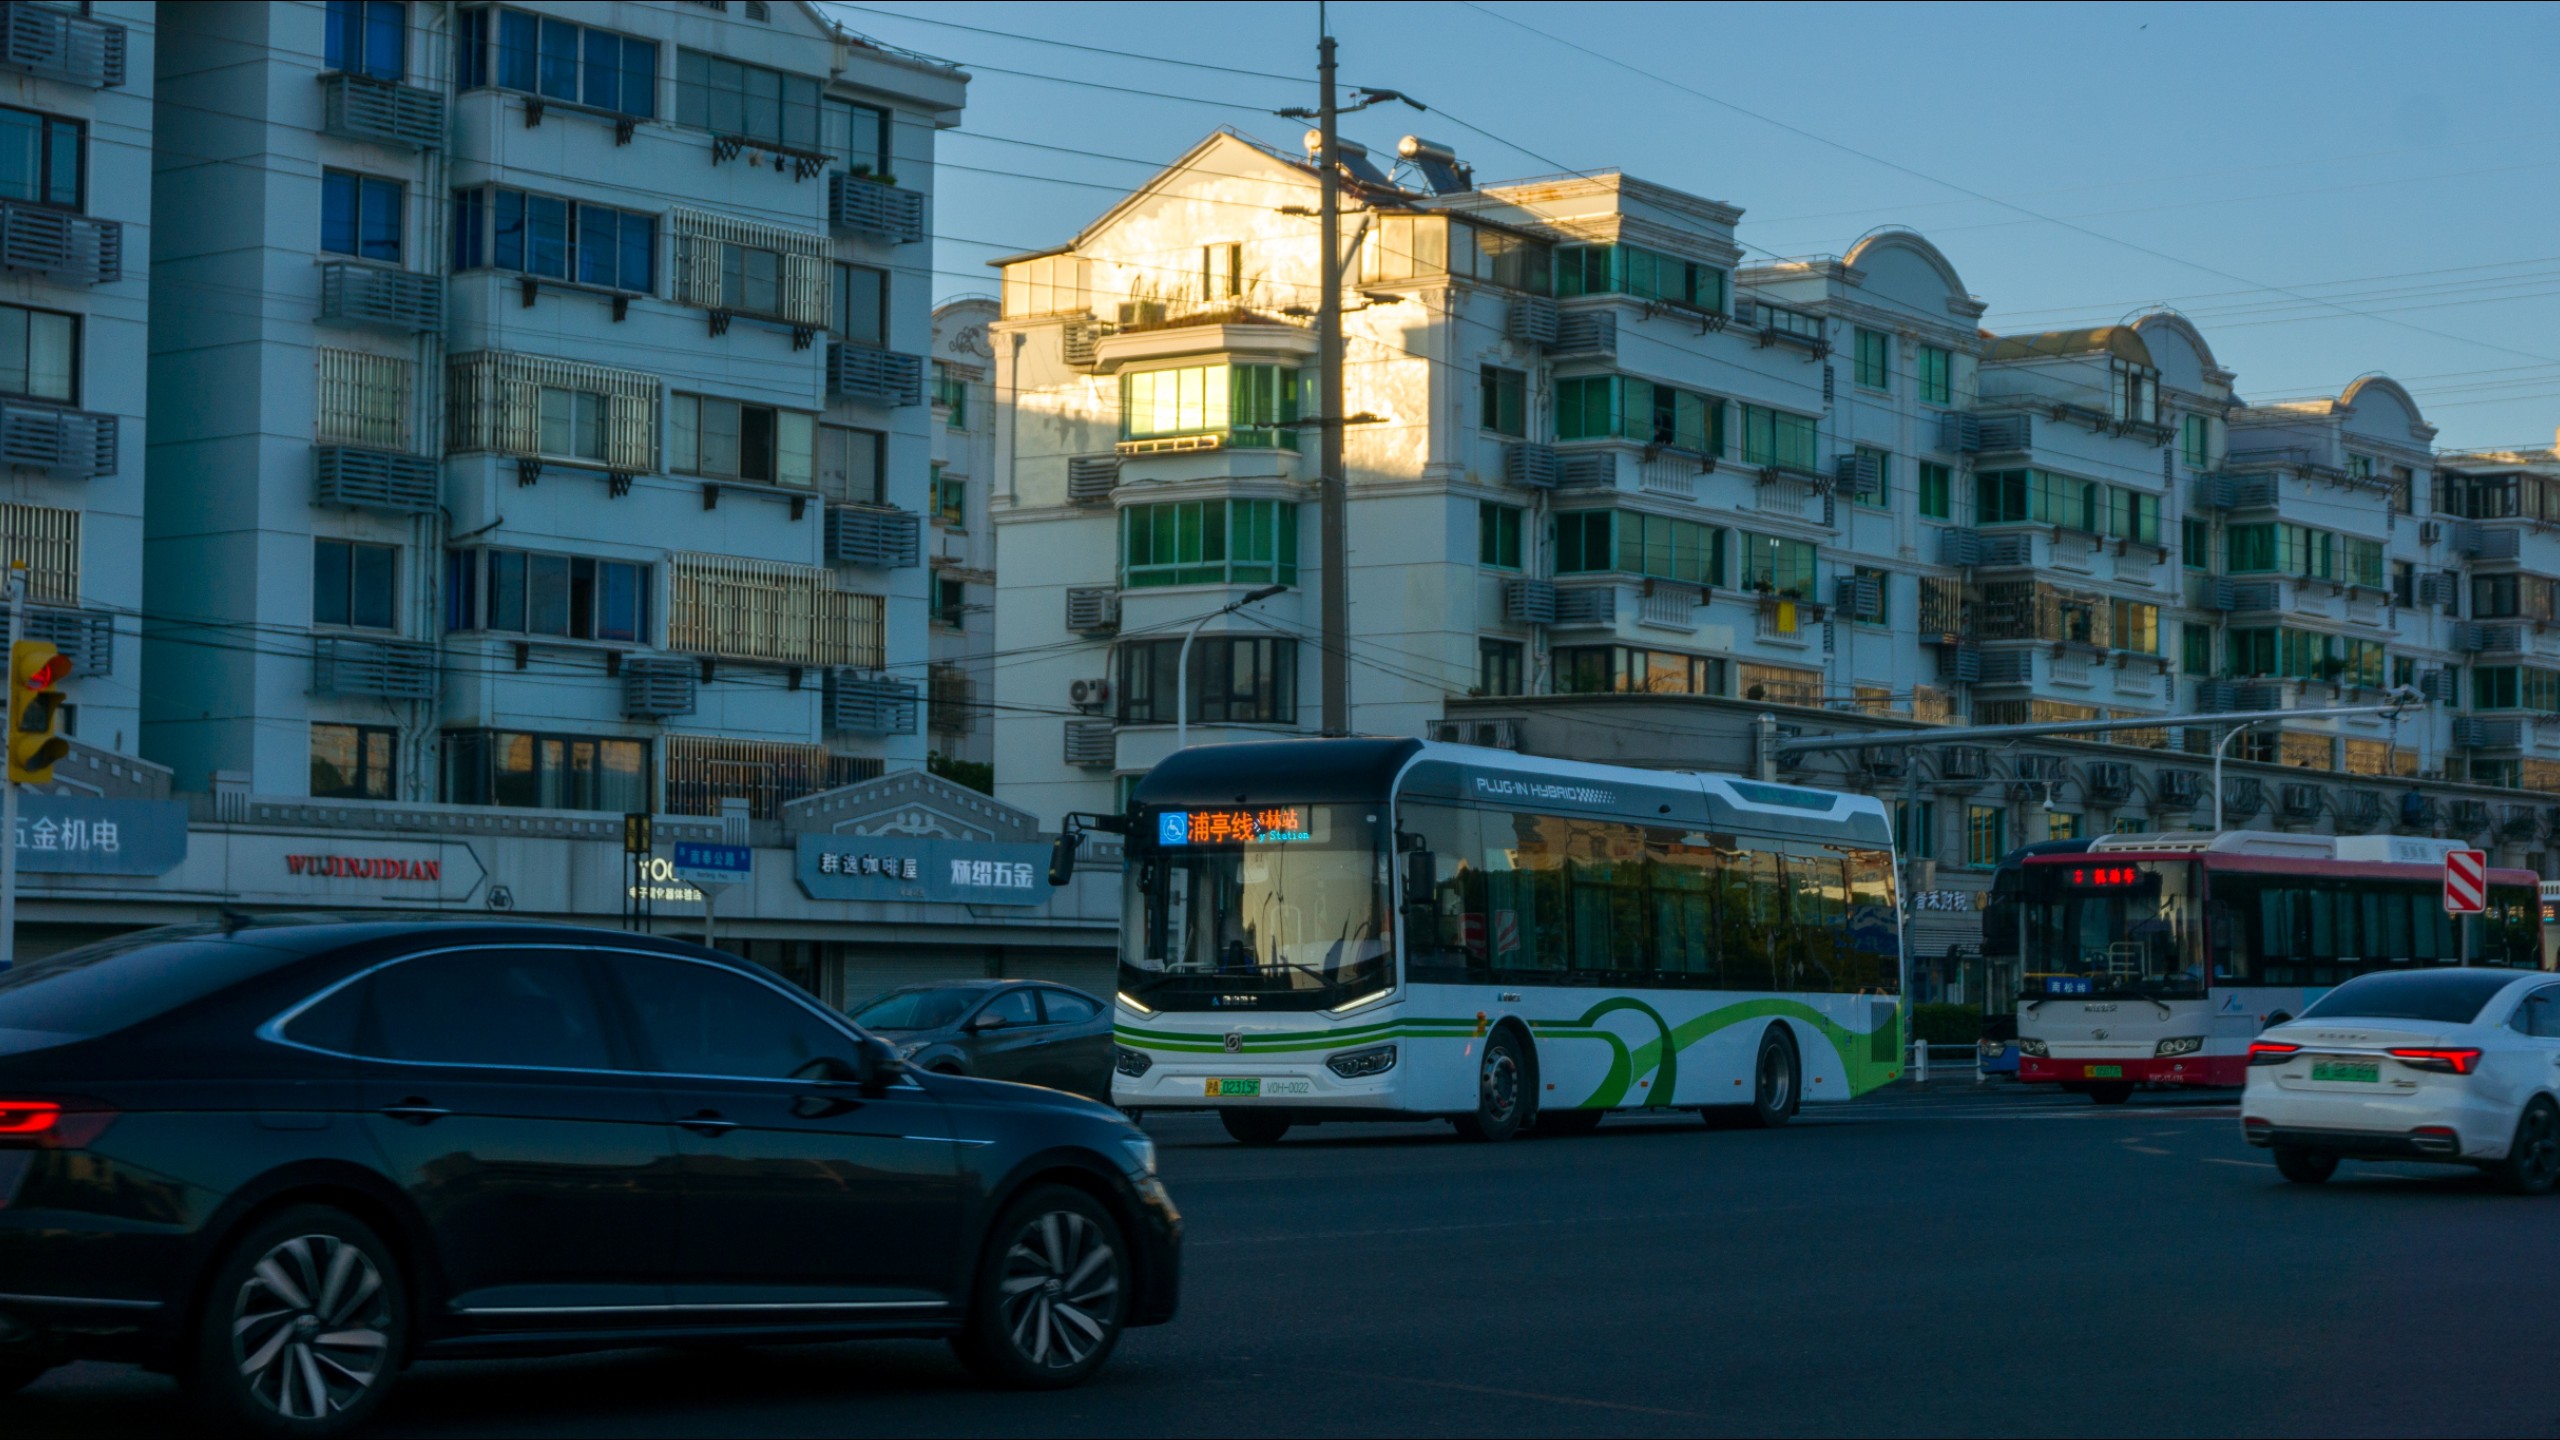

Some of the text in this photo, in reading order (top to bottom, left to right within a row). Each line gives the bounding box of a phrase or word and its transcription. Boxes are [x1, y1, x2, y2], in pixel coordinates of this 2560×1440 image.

[1476, 777, 1578, 801] PLUG-IN HYBRID
[1188, 811, 1255, 843] 浦亭线
[1269, 830, 1310, 843] Station
[285, 854, 441, 881] WUJINJIDIAN
[819, 852, 919, 881] 群逸咖啡屋
